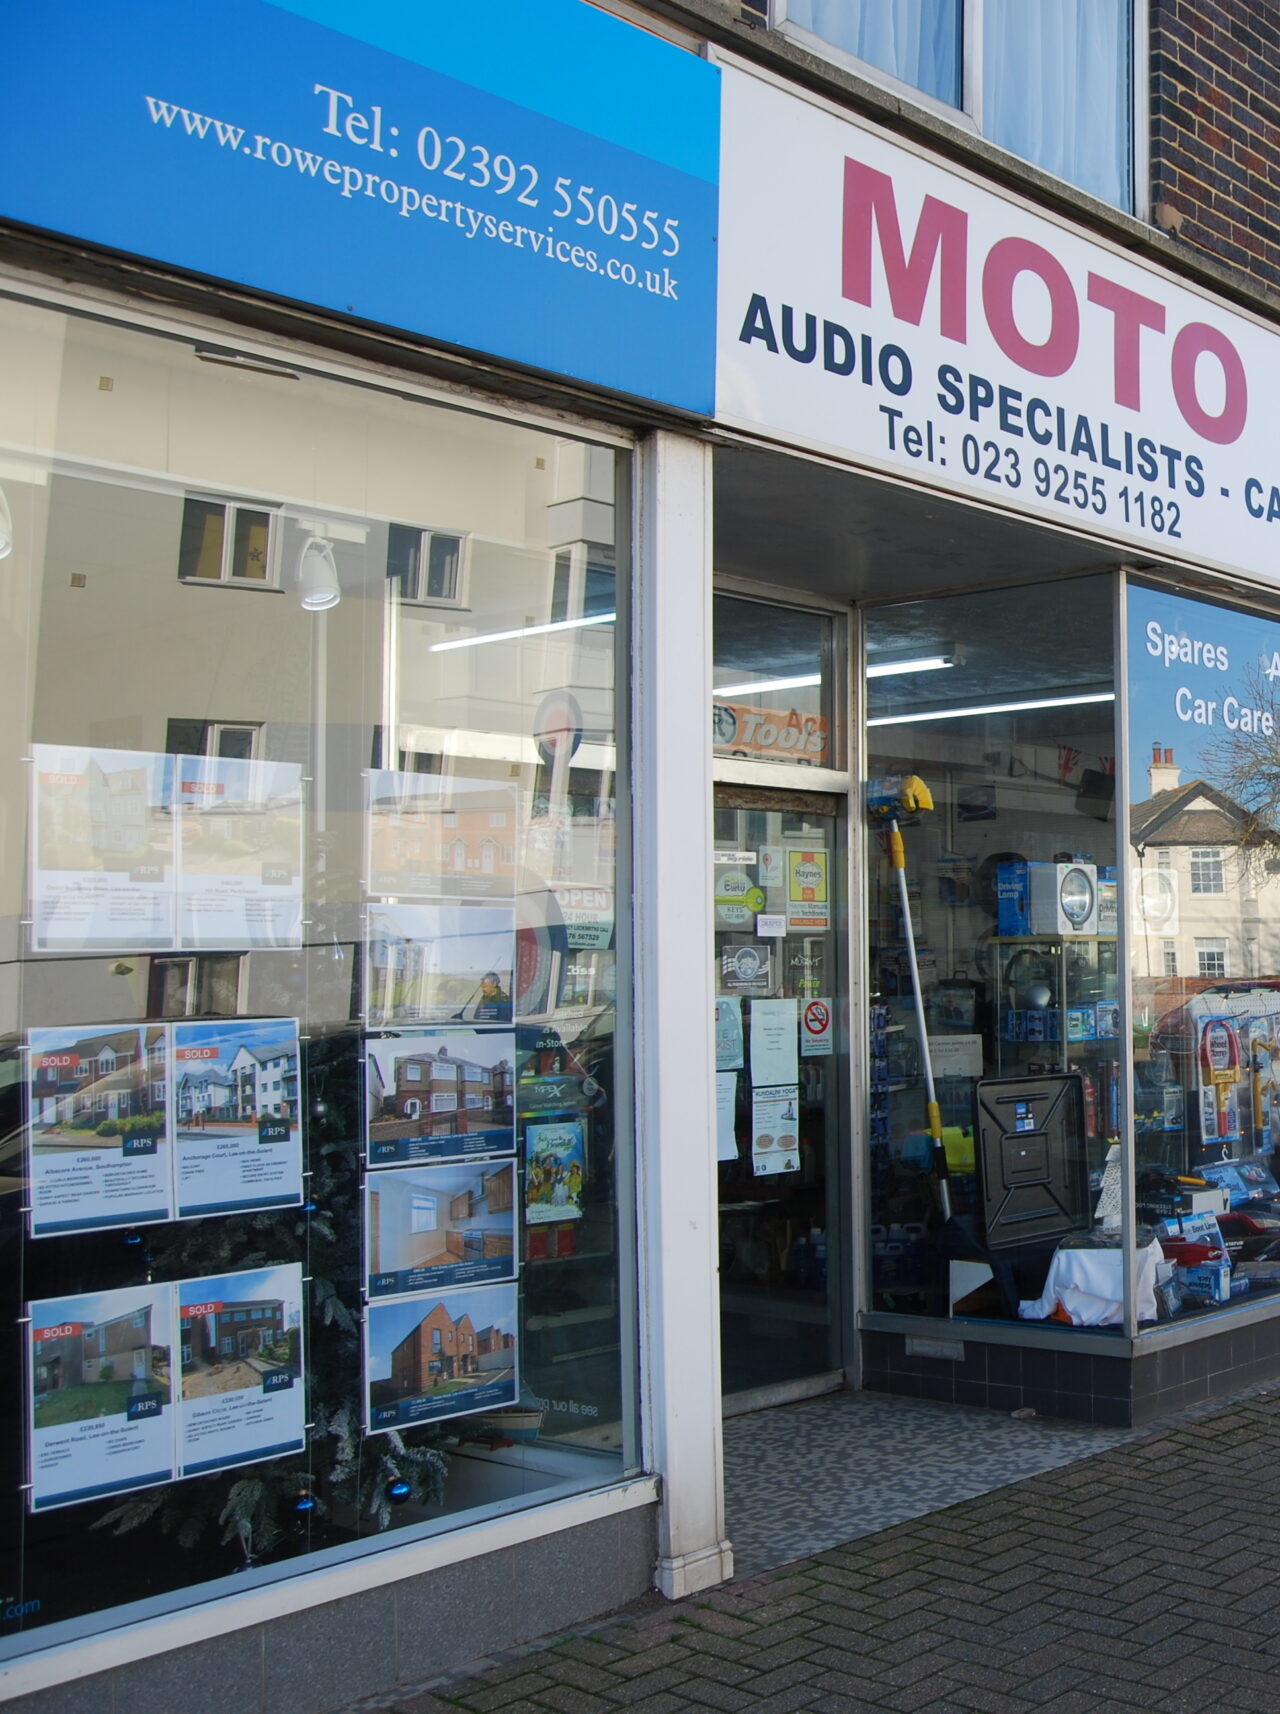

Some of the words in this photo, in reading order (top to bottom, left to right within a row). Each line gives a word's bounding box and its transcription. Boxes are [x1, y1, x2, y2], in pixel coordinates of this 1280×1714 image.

[313, 83, 400, 158] Tel:
[416, 126, 539, 208] 02392
[553, 176, 680, 257] 550555
[145, 95, 678, 301] www.rowepropertyservices.co.uk
[842, 155, 1248, 446] MOTO
[739, 292, 913, 397] AUDIO
[937, 363, 1205, 498] SPECIALISTS
[879, 403, 946, 466] Tel:
[961, 432, 1022, 488] 023
[1034, 456, 1107, 515] 9255
[1117, 485, 1183, 538] 1182
[1145, 620, 1229, 672] Spares
[1175, 687, 1216, 727] Car
[1223, 697, 1274, 736] Care
[742, 712, 827, 752] Tools
[48, 774, 78, 784] SOLD
[190, 783, 217, 793] SOLD
[795, 870, 822, 879] Haynes
[998, 882, 1023, 891] Driving
[556, 889, 607, 908] OPEN
[998, 891, 1018, 900] Lamp
[185, 1049, 210, 1059] SOLD
[41, 1056, 70, 1066] SOLD
[268, 1126, 286, 1135] RPS
[133, 1138, 152, 1148] RPS
[1191, 1224, 1205, 1234] Boot
[188, 1303, 215, 1315] SOLD
[43, 1325, 73, 1338] SOLD
[271, 1374, 289, 1385] RPS
[137, 1400, 157, 1412] RPS
[383, 1410, 396, 1418] RPS
